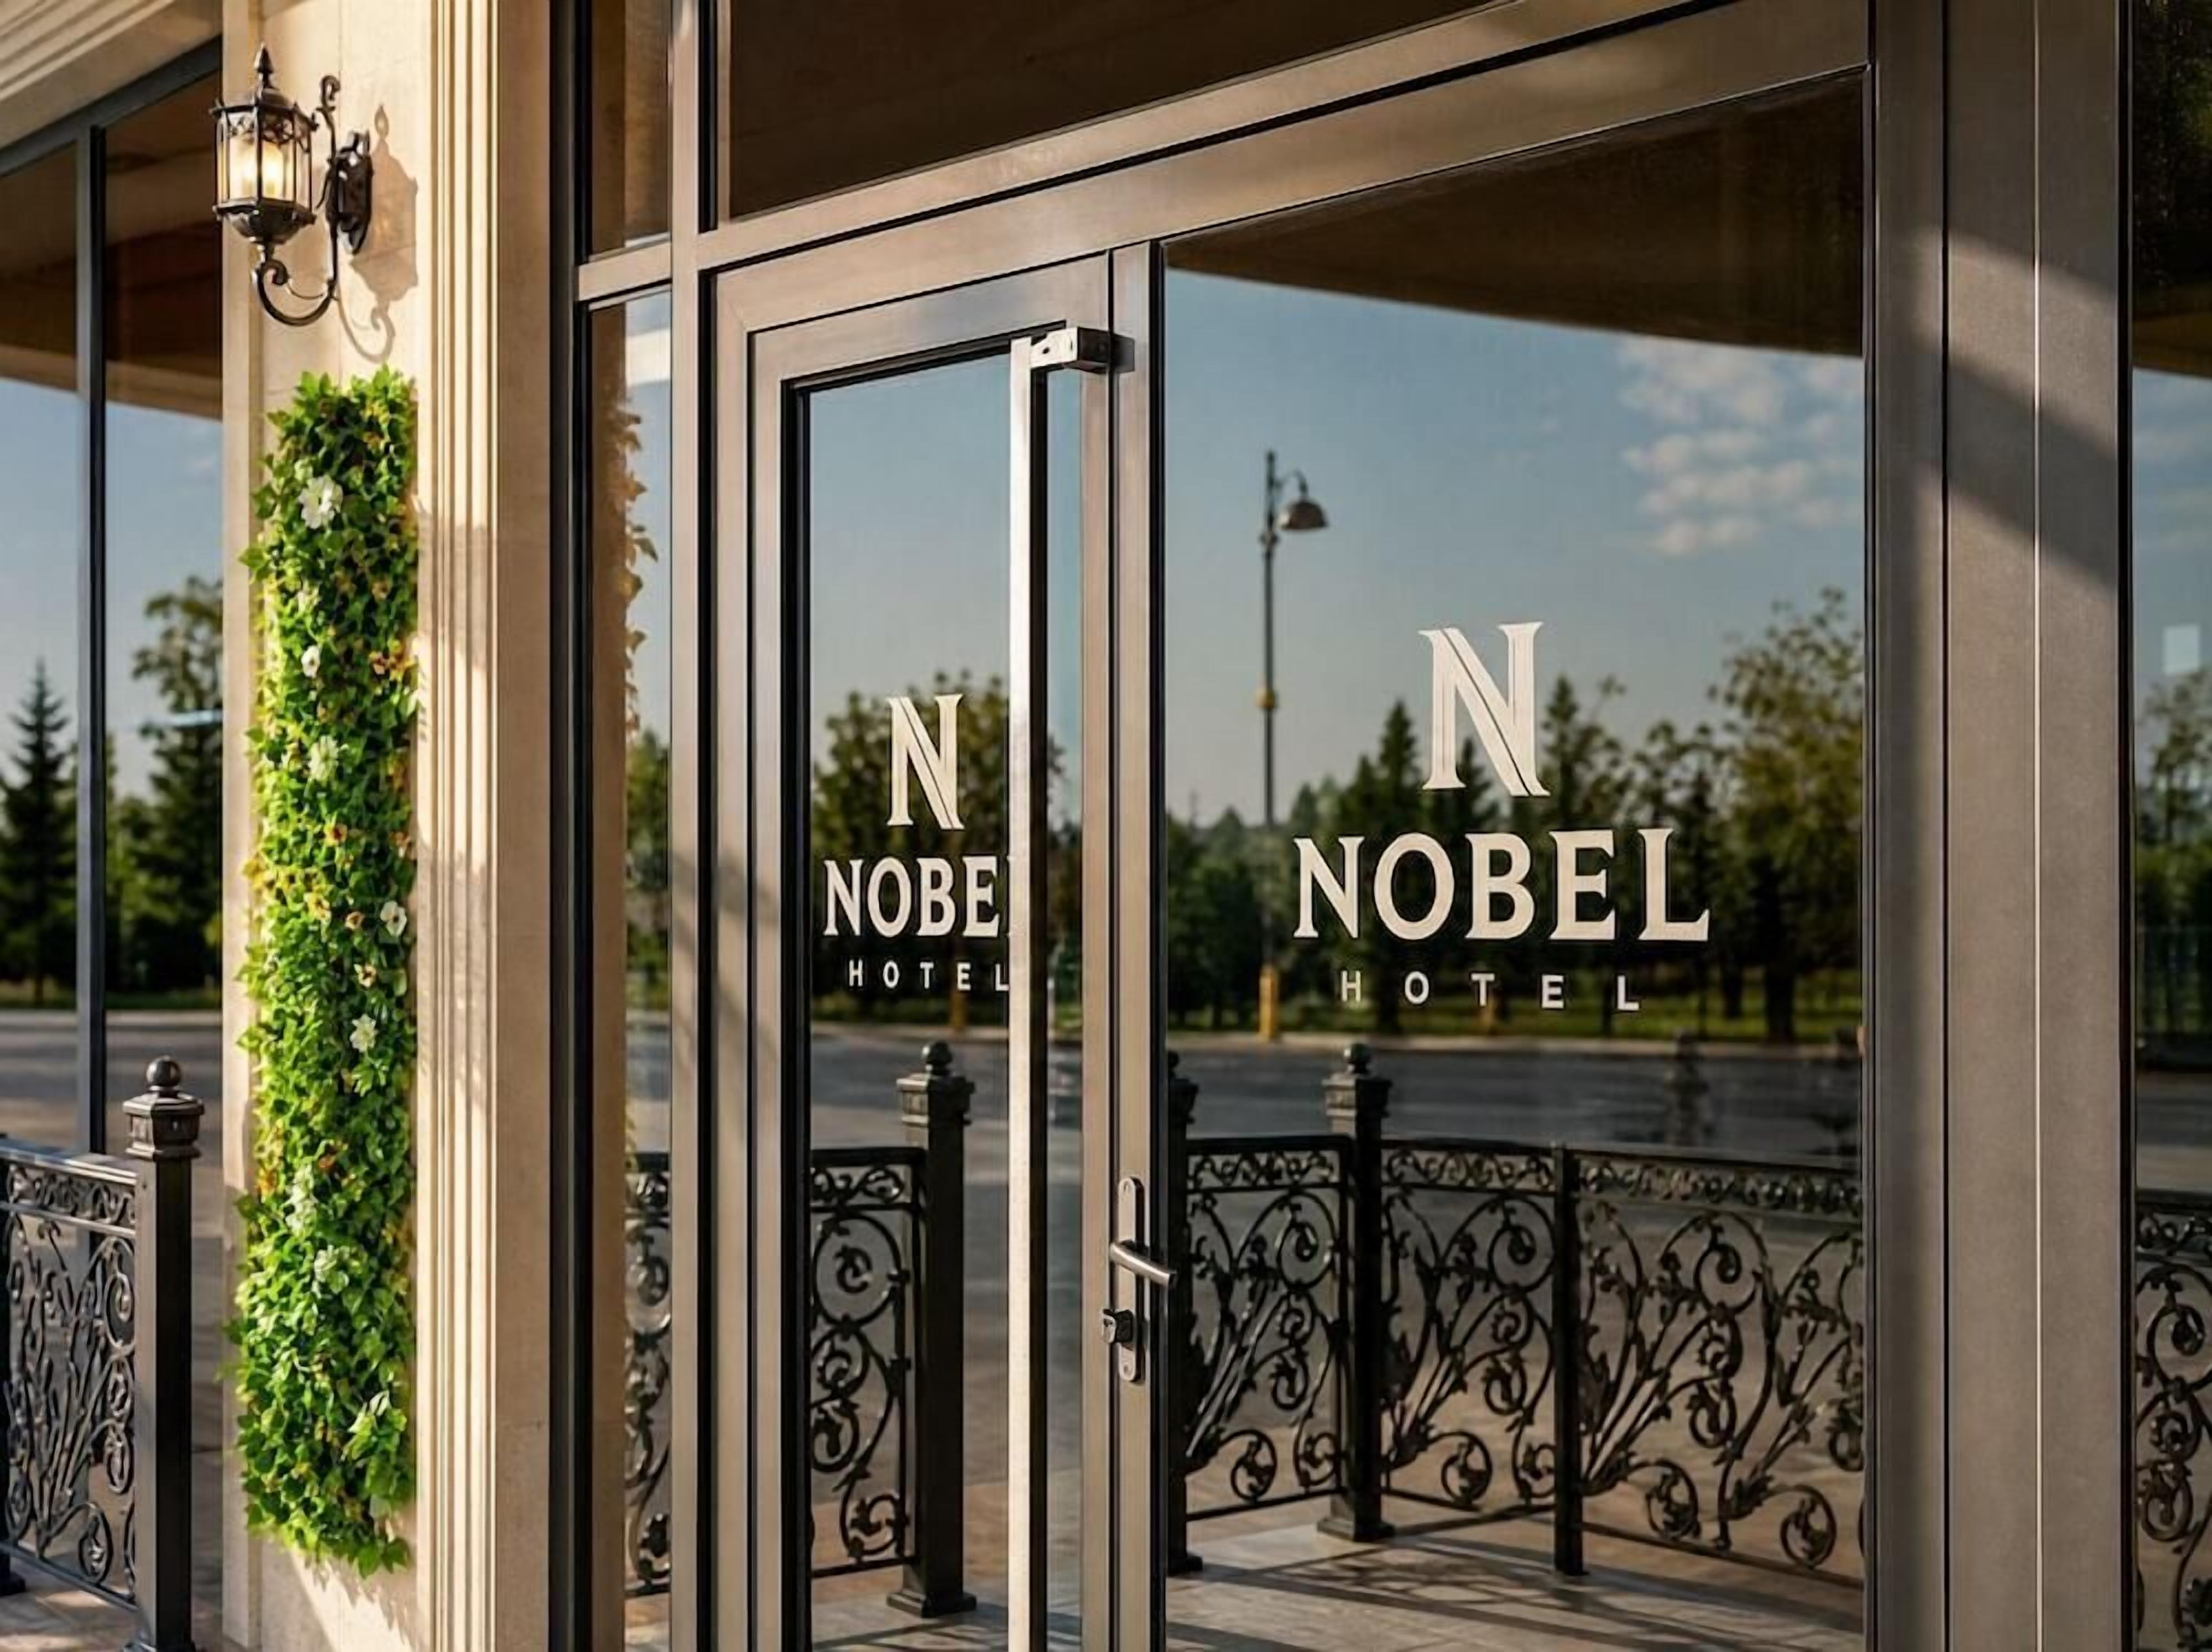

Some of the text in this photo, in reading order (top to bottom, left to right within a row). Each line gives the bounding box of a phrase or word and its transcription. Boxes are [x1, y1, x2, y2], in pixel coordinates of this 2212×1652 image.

[1418, 621, 1550, 796] N
[886, 694, 964, 829] N
[823, 855, 1010, 937] NOBE
[1293, 828, 1709, 942] NOBEL
[849, 960, 1010, 991] HOTEL
[1341, 970, 1640, 1011] HOTEL
